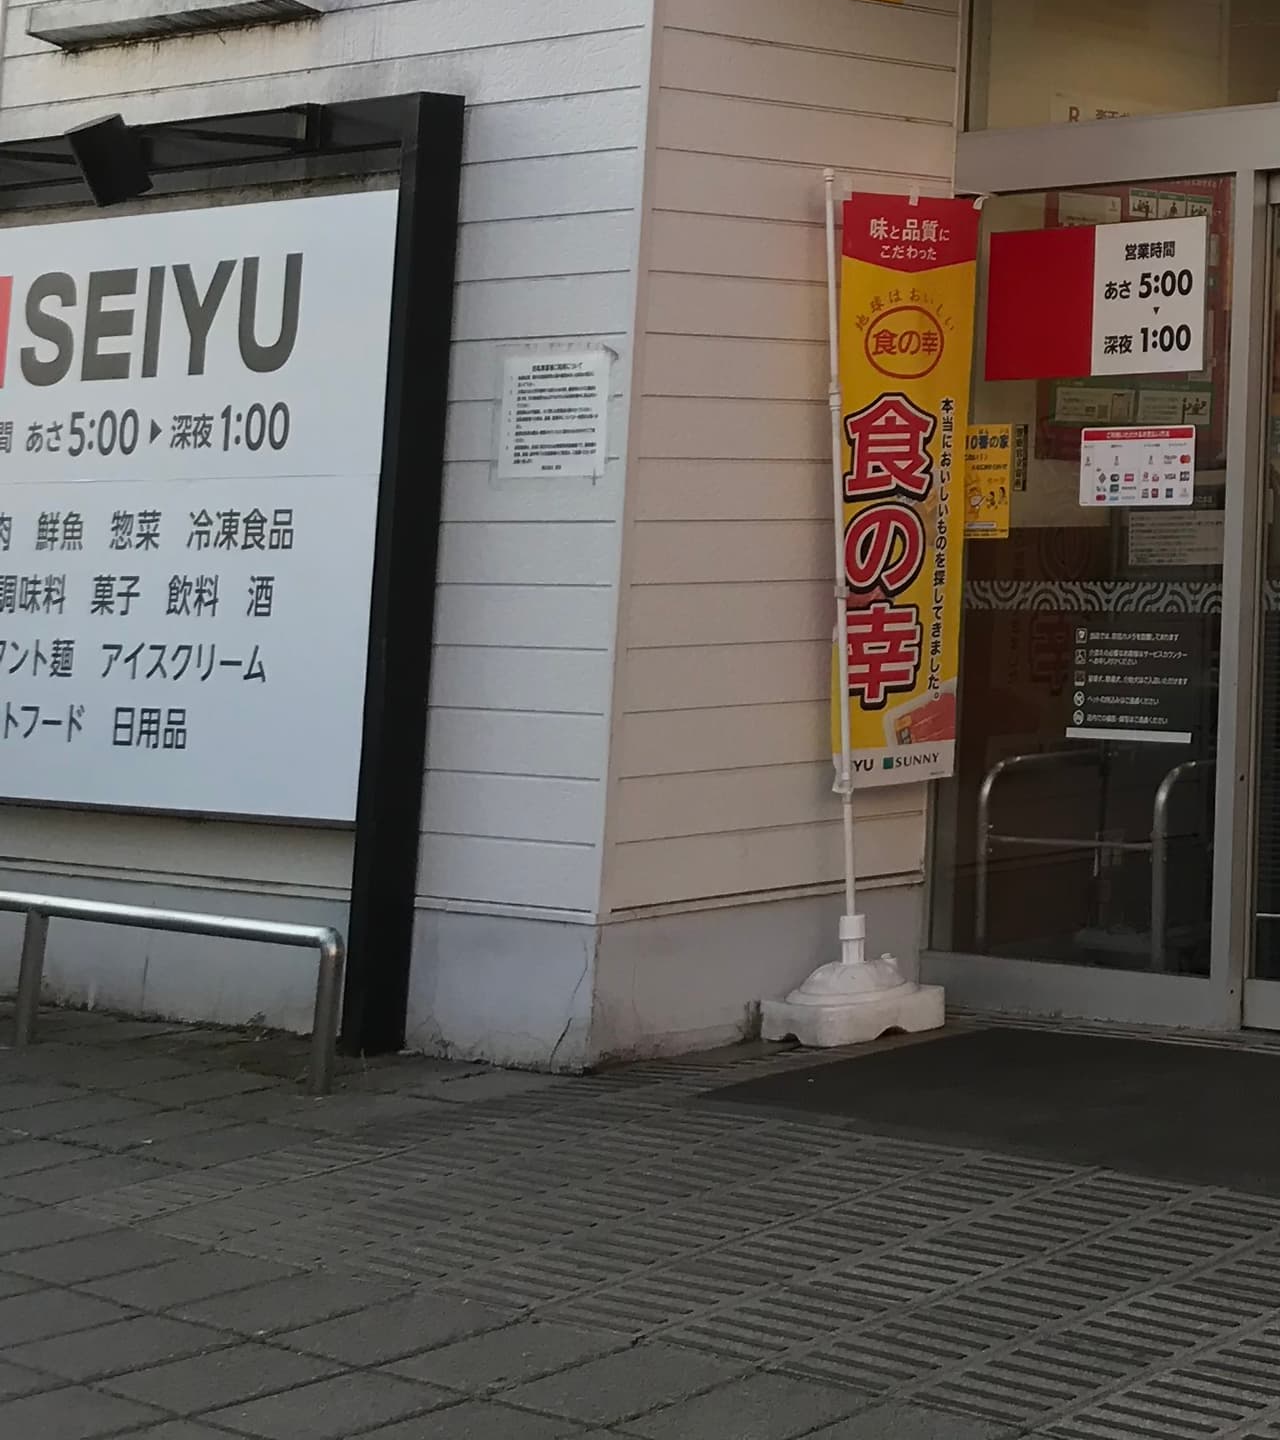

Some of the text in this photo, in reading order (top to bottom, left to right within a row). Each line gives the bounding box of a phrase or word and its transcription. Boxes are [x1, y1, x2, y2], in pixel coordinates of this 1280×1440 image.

[870, 217, 950, 242] 味と品質に
[880, 245, 936, 260] こだわった
[1125, 241, 1175, 261] 営業時間
[1104, 269, 1193, 300] あさ 5:00
[20, 253, 303, 387] SEIYU
[872, 328, 938, 356] 食の幸
[1104, 324, 1191, 355] 深夜 1:00
[35, 511, 83, 551] 鮮魚
[109, 510, 161, 551] 惣菜
[186, 508, 294, 551] 冷凍食品
[845, 392, 937, 710] 食の幸
[0, 573, 275, 617] 調味料 菓子 飲料 酒
[101, 642, 266, 682] アイスクリーム
[4, 702, 187, 749] トフード 日用品
[895, 752, 940, 768] SUNNY
